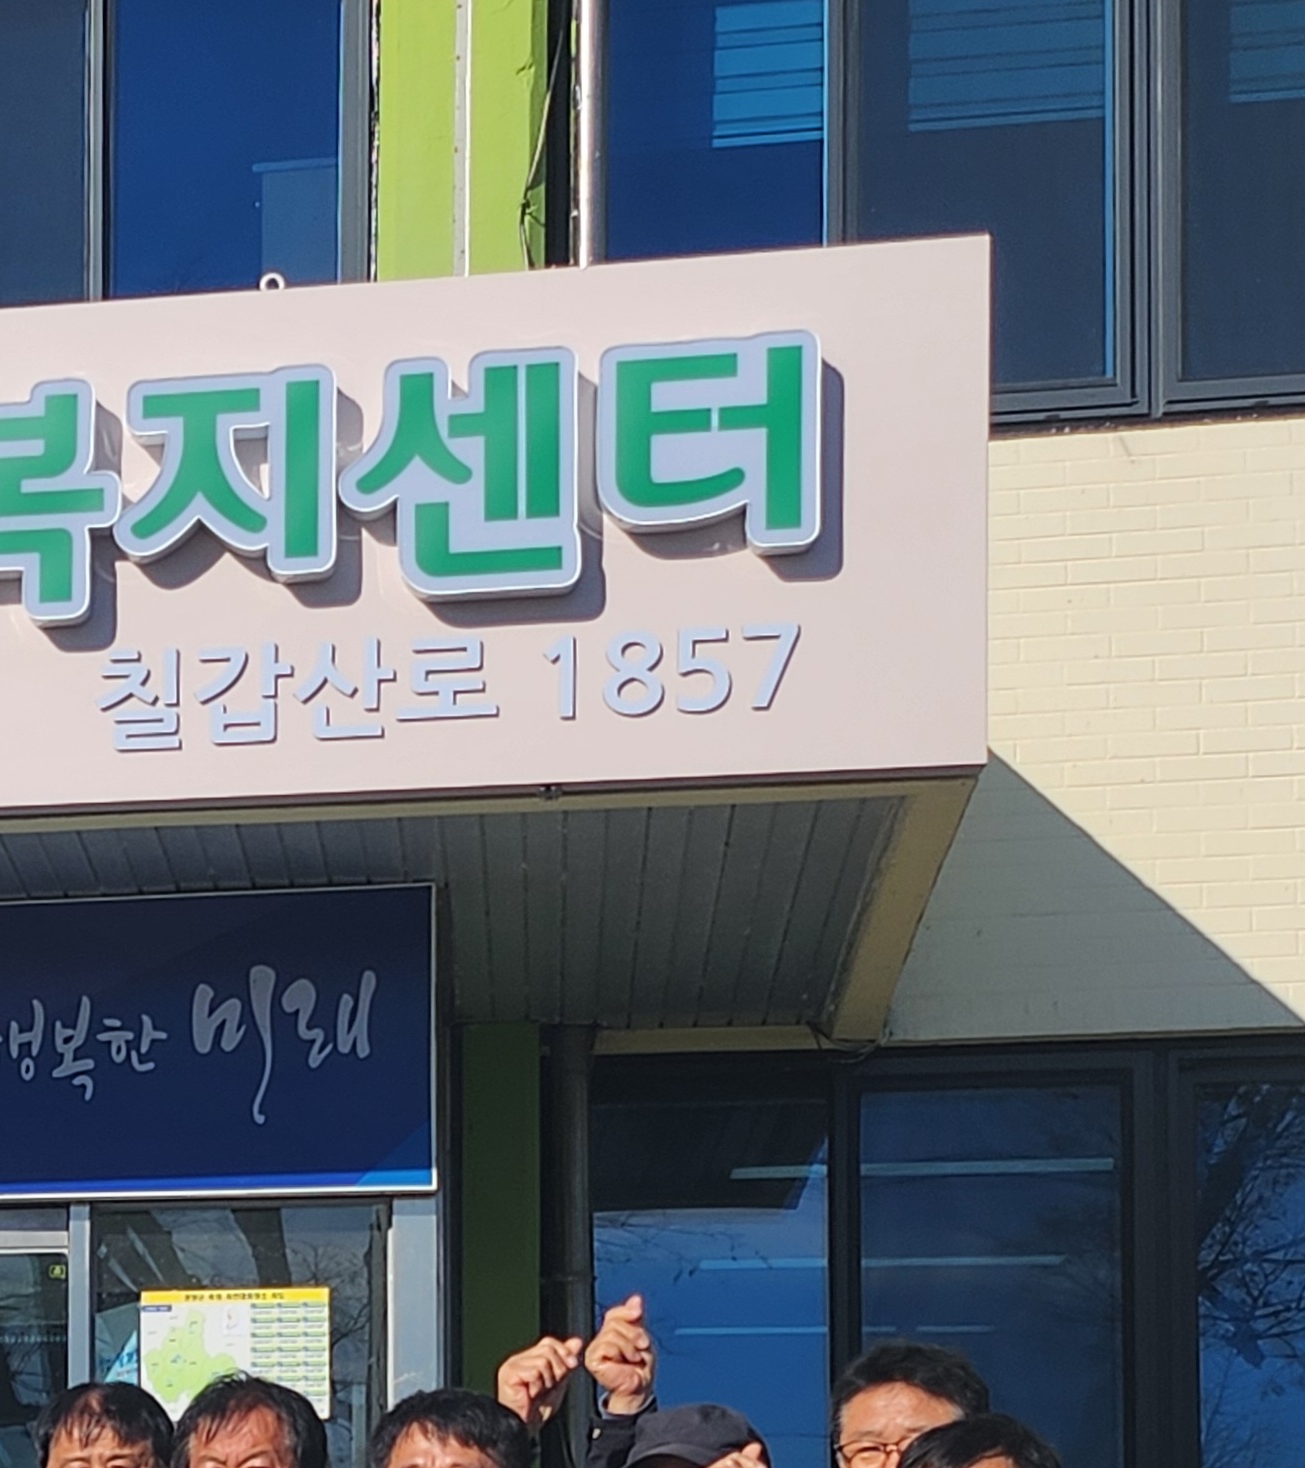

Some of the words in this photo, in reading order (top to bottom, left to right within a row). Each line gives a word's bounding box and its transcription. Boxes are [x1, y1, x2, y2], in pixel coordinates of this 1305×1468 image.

[96, 640, 500, 752] 칠갑산로
[545, 622, 802, 718] 1857
[192, 964, 376, 1125] 미래
